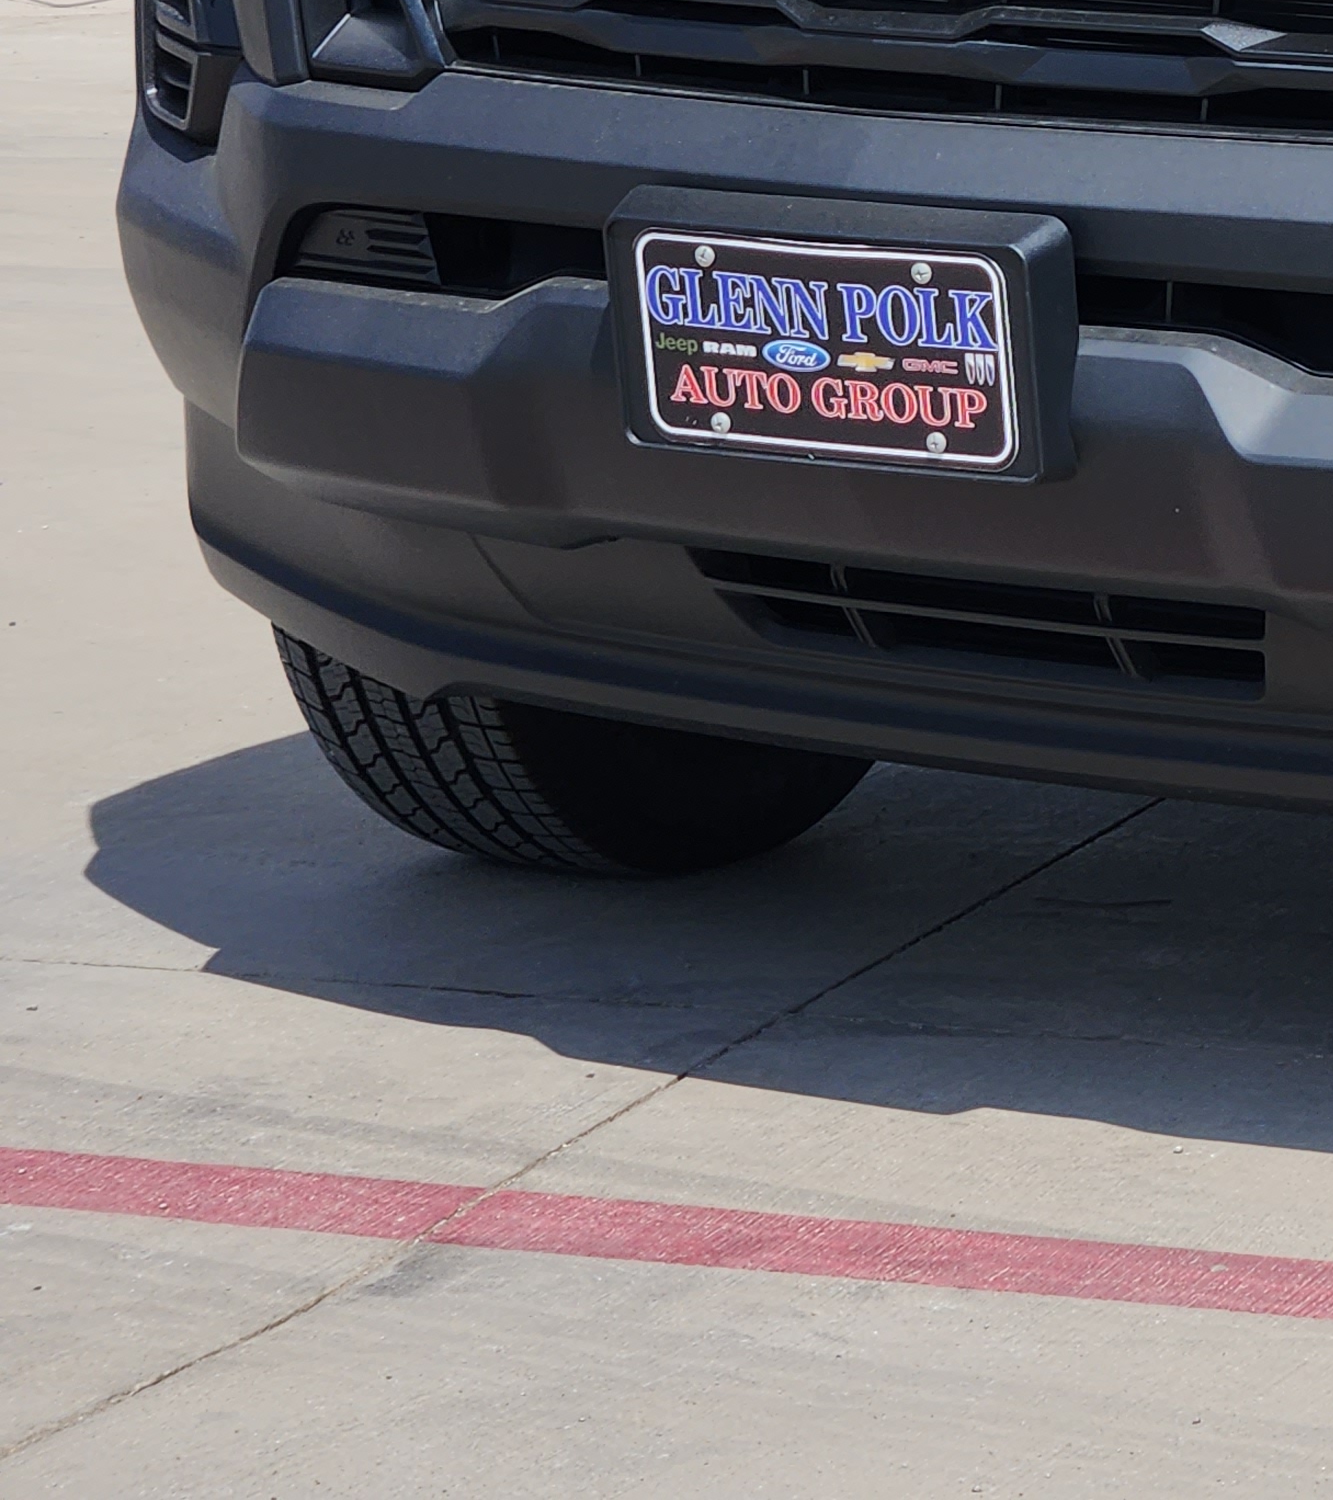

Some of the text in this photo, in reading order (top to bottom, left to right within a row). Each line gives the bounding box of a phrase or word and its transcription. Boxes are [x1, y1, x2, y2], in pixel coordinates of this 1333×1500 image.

[645, 265, 999, 351] GLENN POLK
[655, 332, 959, 375] Jeep RAM Ford GMC
[671, 364, 988, 429] AUTO GROUP
